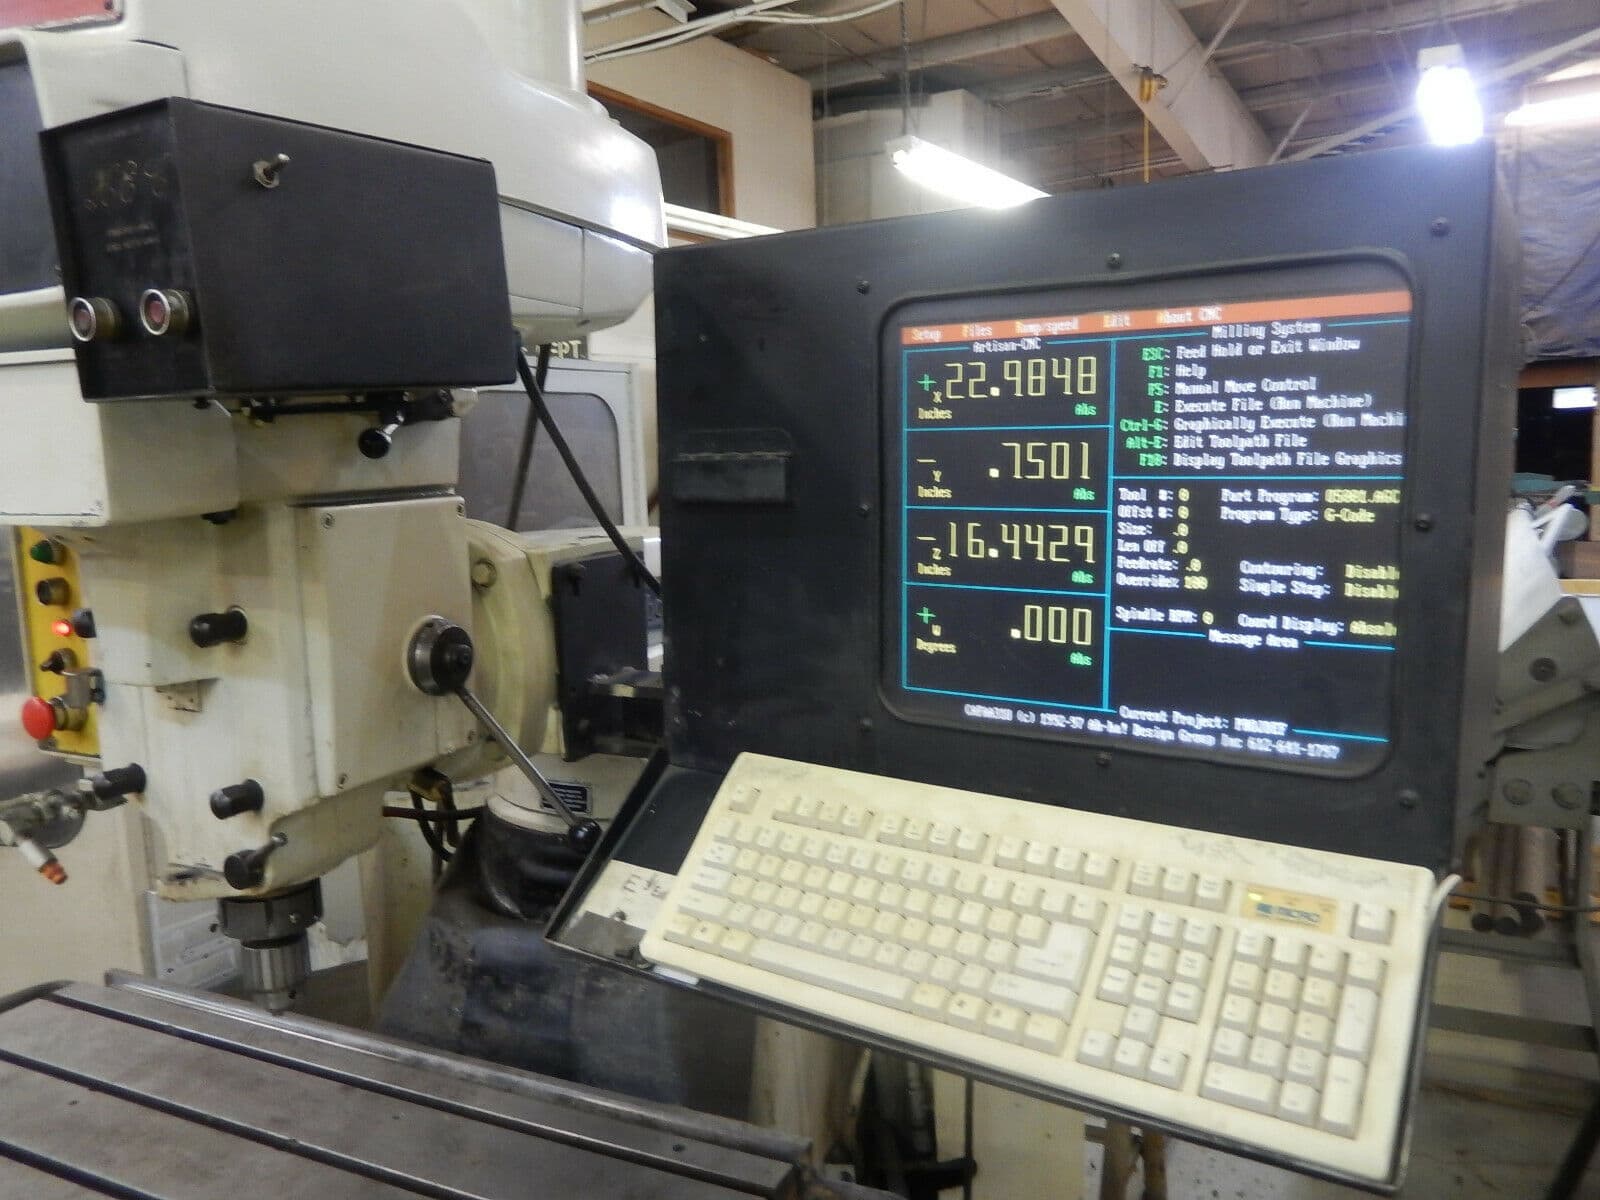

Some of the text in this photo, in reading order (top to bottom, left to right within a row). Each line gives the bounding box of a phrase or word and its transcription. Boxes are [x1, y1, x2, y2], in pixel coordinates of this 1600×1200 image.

[1212, 321, 1321, 340] Milling System
[1176, 345, 1206, 359] Feed
[1211, 343, 1243, 357] Hold
[1248, 344, 1265, 356] or
[1271, 340, 1303, 354] Exit
[1308, 337, 1360, 351] Window
[1175, 363, 1207, 380] Help
[1175, 381, 1219, 395] Manual
[1224, 380, 1256, 394] Move
[1261, 376, 1316, 392] Control
[918, 407, 952, 420] Inches
[1175, 399, 1226, 413] Execute
[1231, 397, 1264, 412] File
[1173, 416, 1255, 433] Graphically
[1260, 415, 1316, 429] Execute
[1173, 434, 1204, 448] Edit
[1209, 434, 1269, 451] Toolpath
[1274, 433, 1308, 448] File
[1173, 453, 1225, 469] Display
[1229, 452, 1292, 469] Toolpath
[1296, 452, 1330, 466] File
[1334, 451, 1402, 469] Graphics
[918, 485, 952, 499] Inches
[1119, 488, 1146, 501] Tool
[1221, 488, 1252, 502] Part
[1257, 488, 1319, 506] Program:
[1220, 506, 1376, 525] Program Type: G-Code
[918, 562, 952, 576] Inches
[1239, 578, 1286, 596] Single
[1290, 580, 1331, 599] Step:
[1115, 605, 1165, 622] Spindle
[1282, 615, 1344, 636] Display:
[1208, 629, 1299, 648] Message Area
[1119, 705, 1168, 722] Current
[1172, 710, 1229, 730] Project:
[1132, 723, 1175, 741] Design
[1178, 729, 1216, 747] Group
